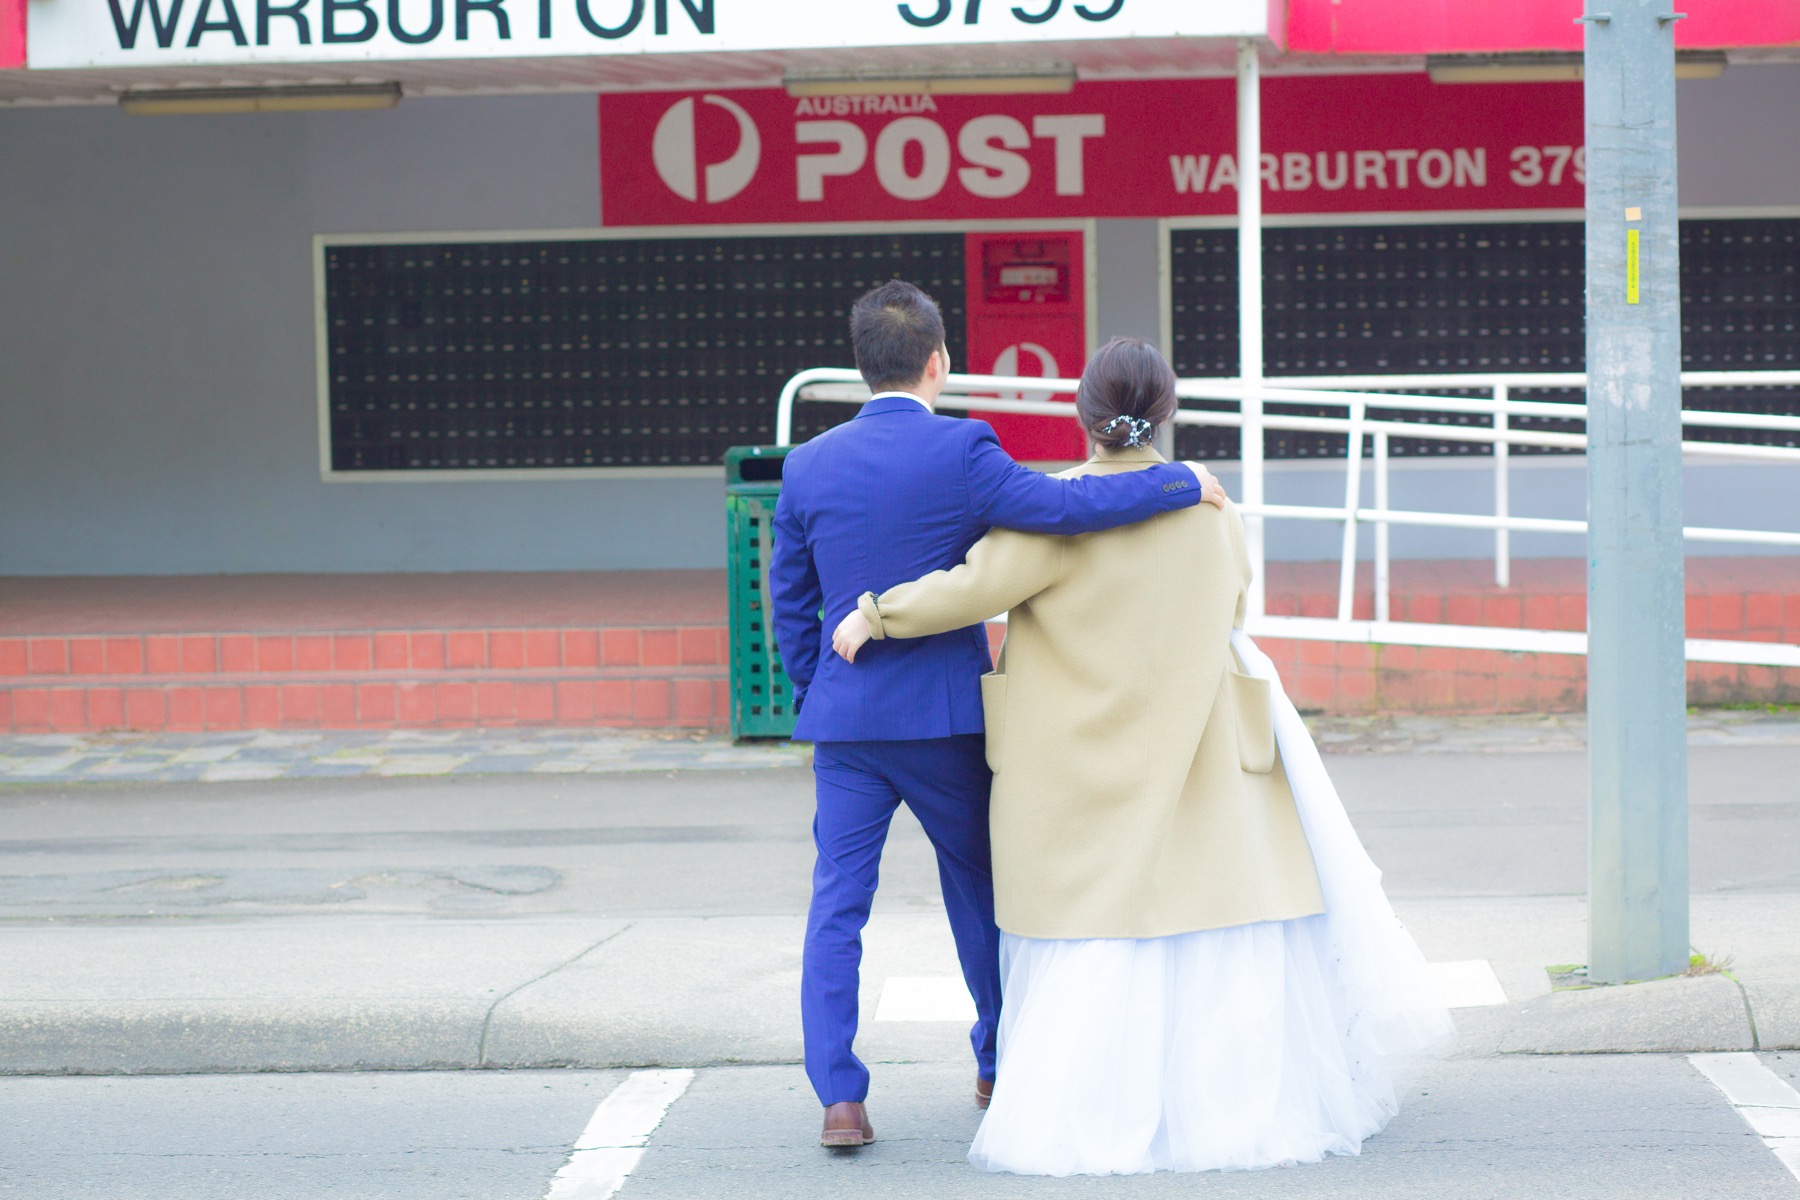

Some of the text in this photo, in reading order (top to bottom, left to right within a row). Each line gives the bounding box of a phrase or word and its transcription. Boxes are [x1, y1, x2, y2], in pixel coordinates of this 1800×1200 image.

[795, 94, 938, 116] AUSTRALIA
[795, 113, 1105, 201] POST
[1168, 148, 1487, 194] WARBURTON
